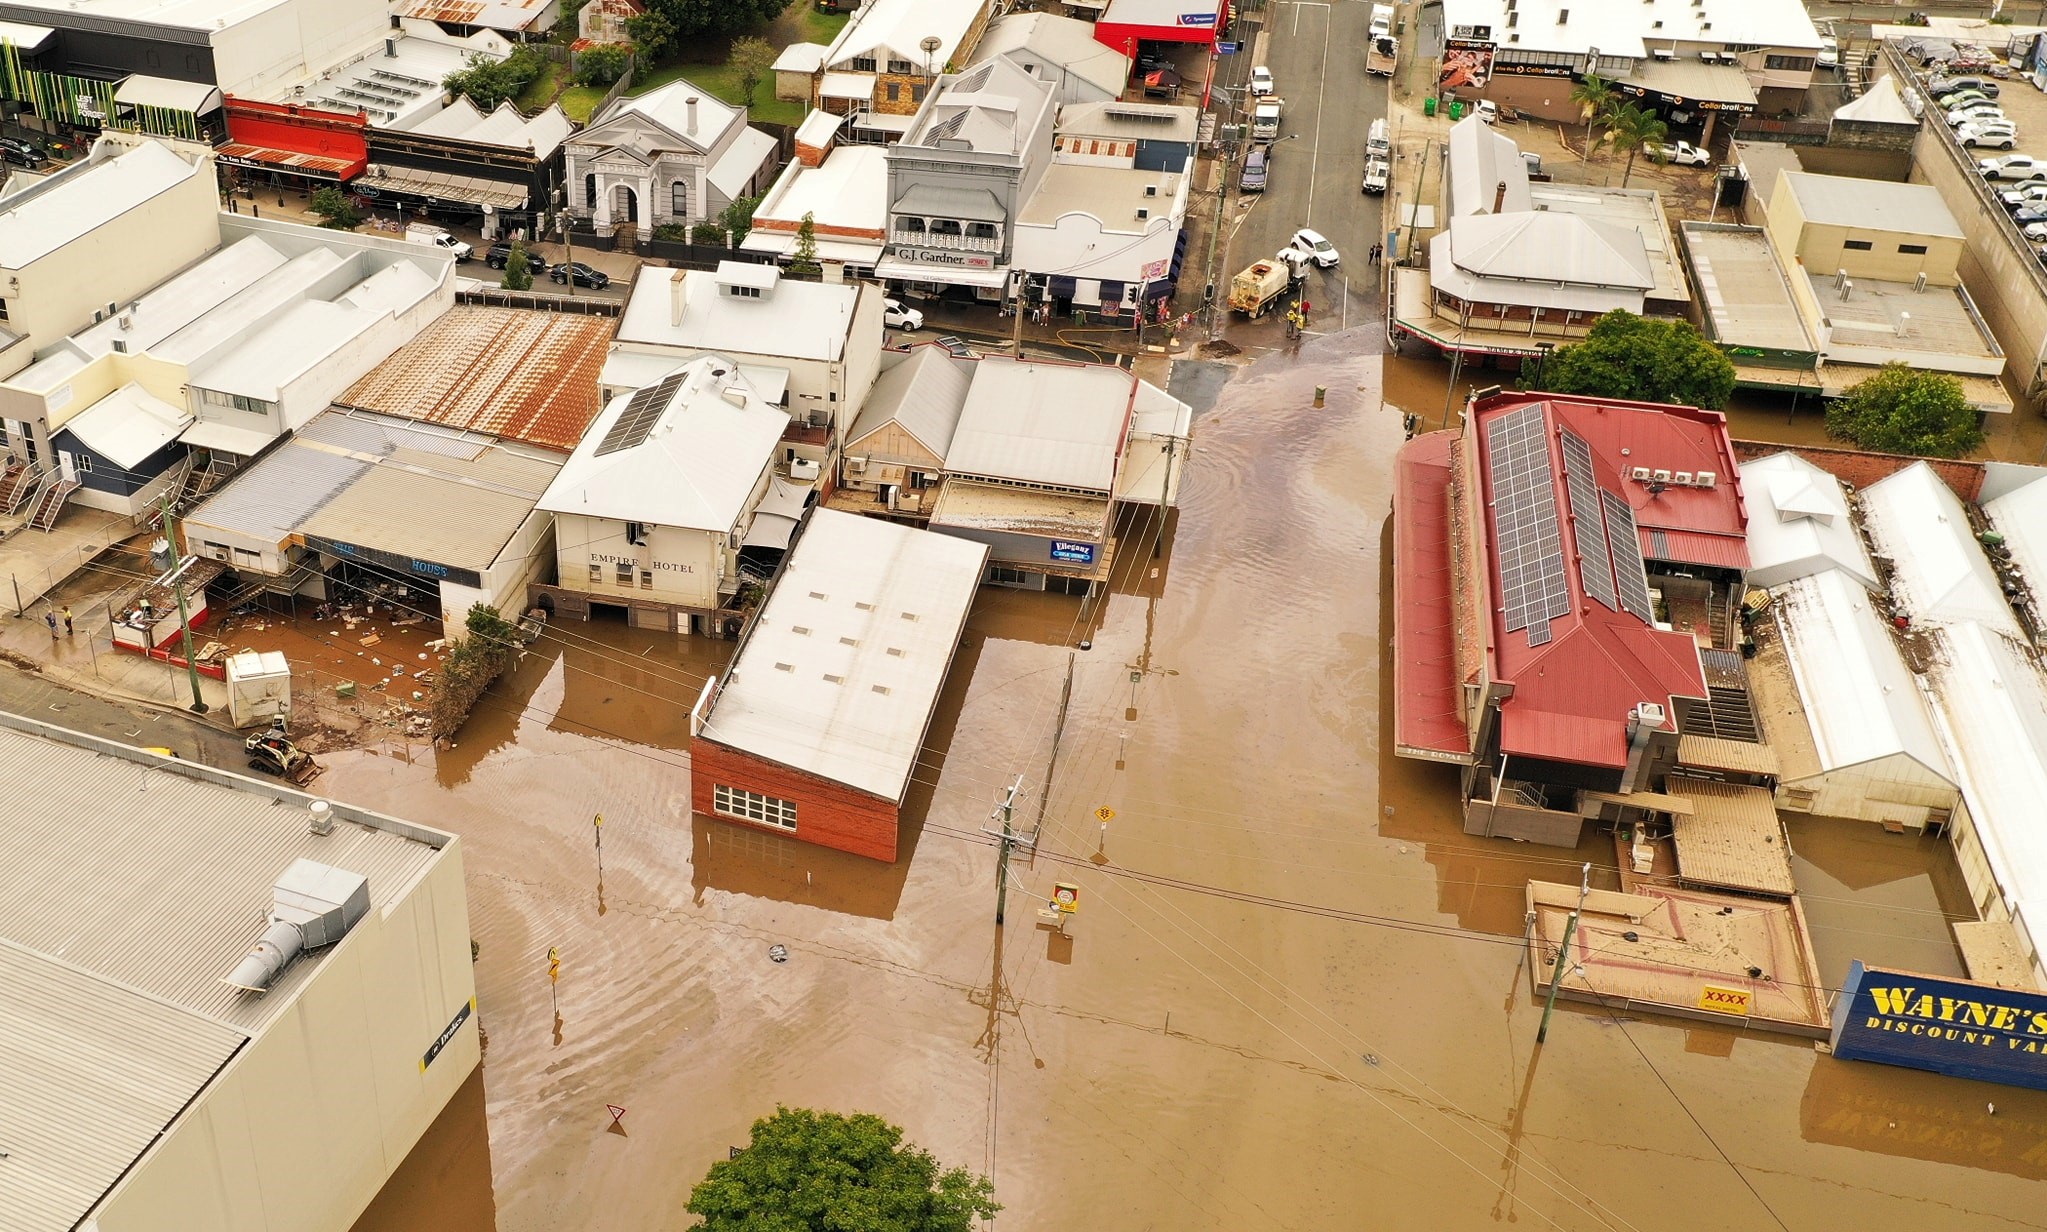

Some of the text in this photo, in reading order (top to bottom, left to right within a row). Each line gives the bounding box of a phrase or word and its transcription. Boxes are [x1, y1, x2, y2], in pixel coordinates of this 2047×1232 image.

[1526, 66, 1570, 76] Cellarbrations
[1698, 101, 1754, 112] Cellarbrations
[899, 249, 917, 261] G.J.
[920, 251, 965, 265] Gardner.
[412, 558, 448, 577] HOUSE
[591, 553, 694, 574] EMPIRE HOTEL
[1407, 748, 1463, 761] THE ROYAL
[1705, 991, 1746, 1006] XXXX
[1869, 987, 2047, 1035] WAYNE'S
[1866, 1017, 1995, 1047] DISCOUNT
